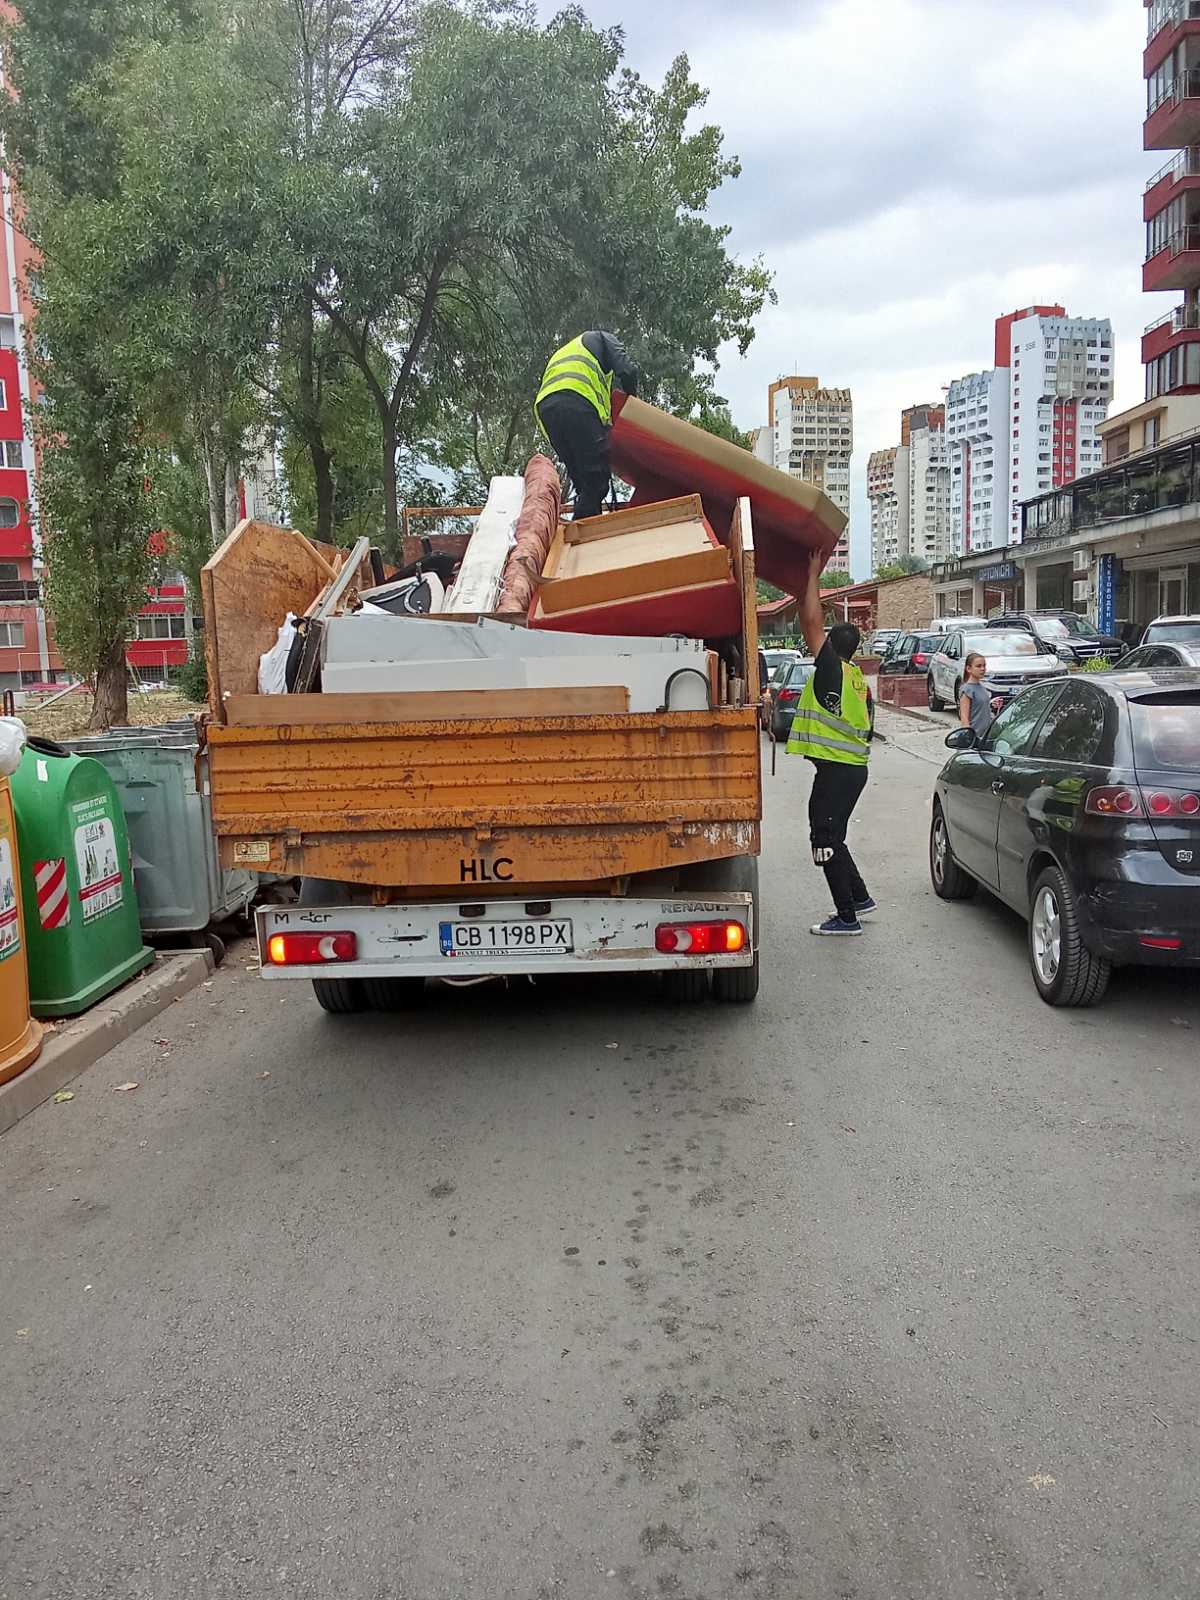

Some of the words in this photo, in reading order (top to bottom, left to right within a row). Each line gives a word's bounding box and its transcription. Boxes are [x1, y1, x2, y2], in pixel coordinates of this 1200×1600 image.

[460, 858, 514, 881] HLC
[661, 903, 729, 913] RENAULT
[455, 927, 482, 946] CB
[488, 925, 535, 946] 1198
[540, 924, 567, 944] PX
